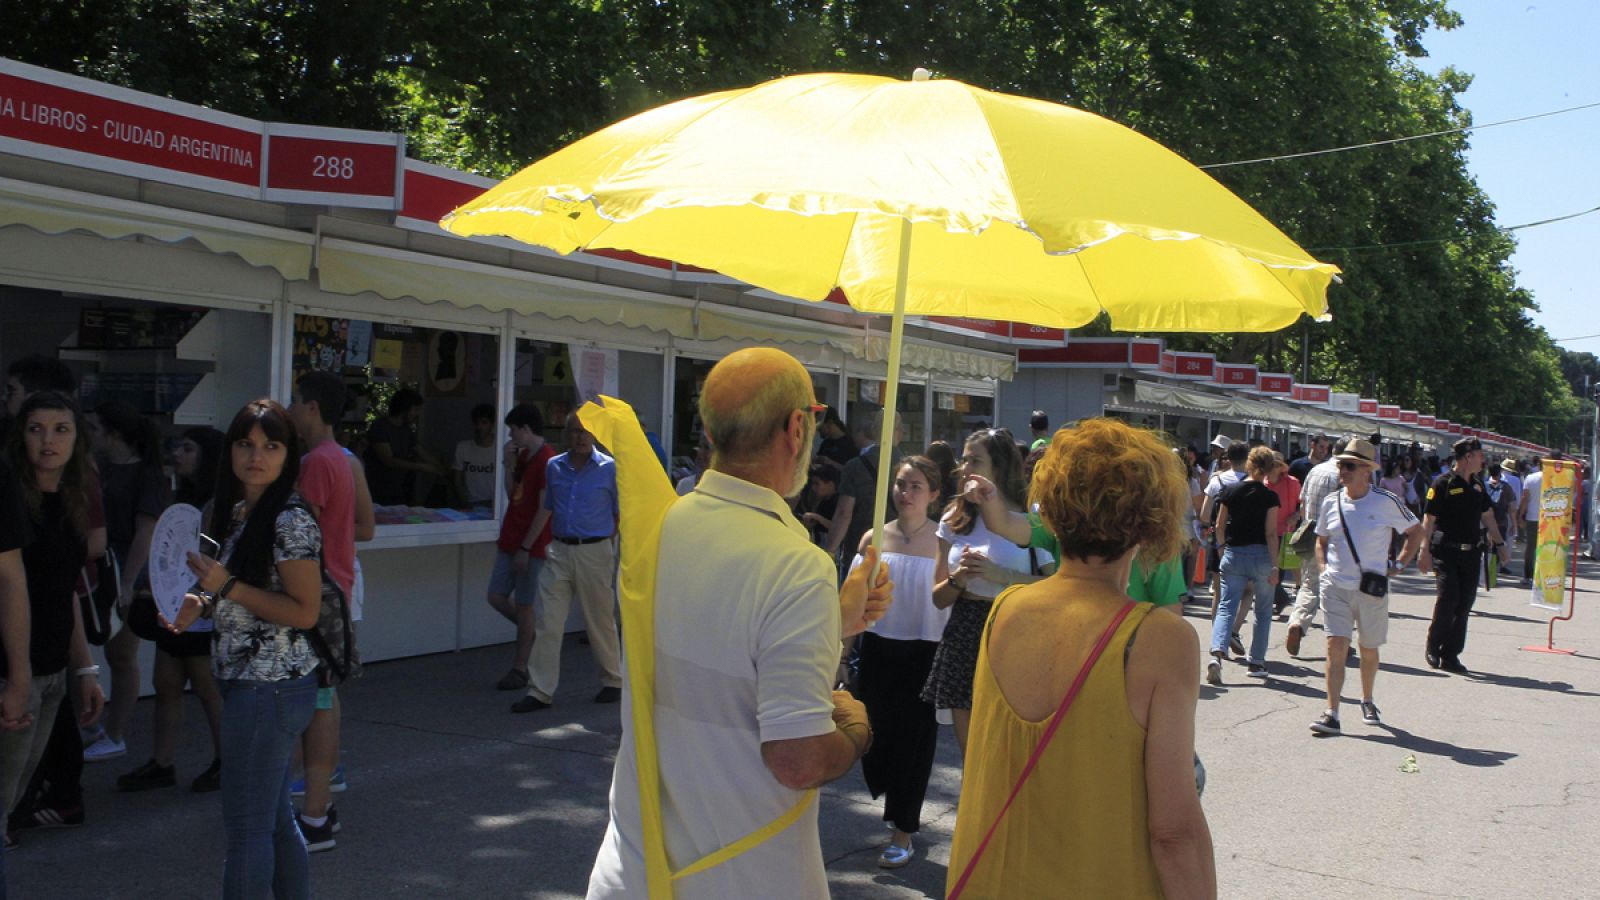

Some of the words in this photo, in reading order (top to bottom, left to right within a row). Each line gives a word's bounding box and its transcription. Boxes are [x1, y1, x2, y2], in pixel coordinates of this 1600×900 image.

[21, 101, 87, 133] LIBROS
[103, 119, 165, 149] CIUDAD
[168, 134, 254, 168] ARGENTINA
[312, 155, 354, 179] 288
